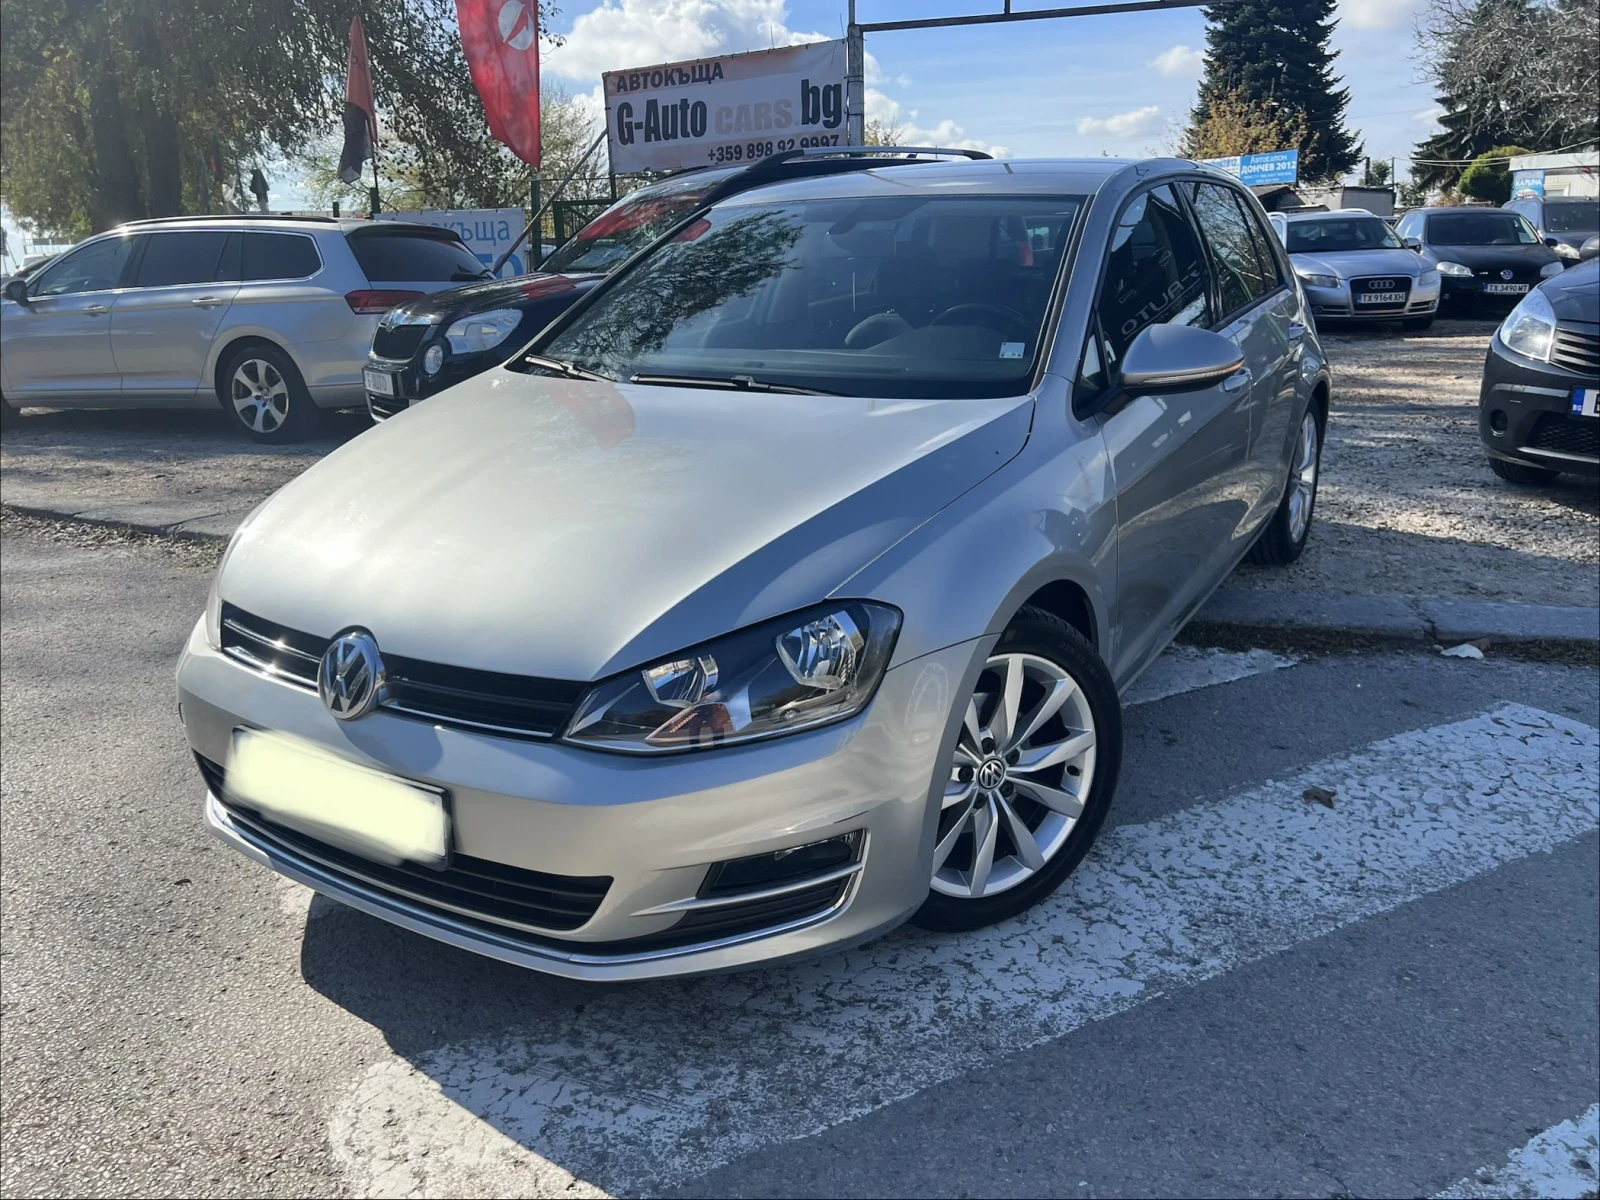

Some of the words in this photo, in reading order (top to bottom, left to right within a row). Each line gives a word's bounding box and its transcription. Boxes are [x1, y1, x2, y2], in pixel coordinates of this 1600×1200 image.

[616, 62, 724, 92] АВТОКЪЩА
[616, 98, 708, 146] G-Auto
[707, 144, 743, 163] +359
[747, 141, 773, 159] 898
[1241, 163, 1275, 175] ДОНЧЕВ
[1275, 161, 1296, 171] 2012
[1373, 293, 1393, 302] 9164
